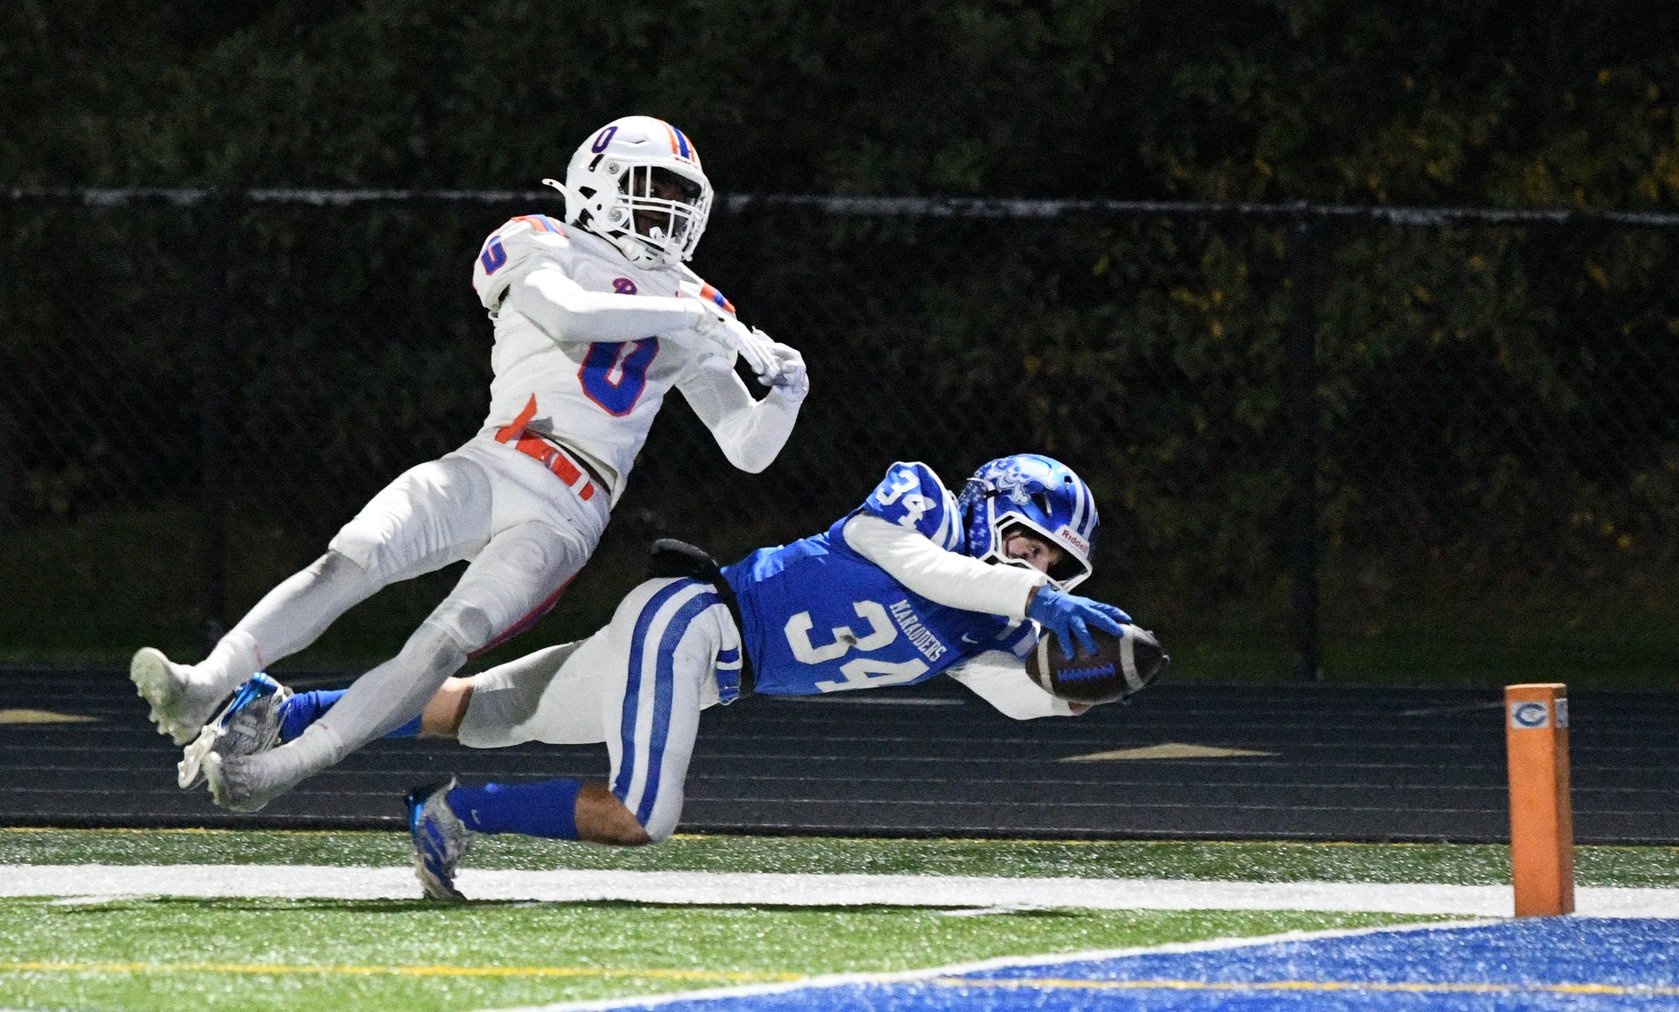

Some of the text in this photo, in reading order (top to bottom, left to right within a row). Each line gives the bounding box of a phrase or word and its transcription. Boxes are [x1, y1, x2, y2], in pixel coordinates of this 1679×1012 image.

[591, 126, 618, 153] 0
[577, 336, 660, 417] 0
[876, 469, 937, 531] 34
[1062, 529, 1090, 553] Riddell
[784, 600, 930, 693] 34
[889, 599, 948, 662] MARAUDERS
